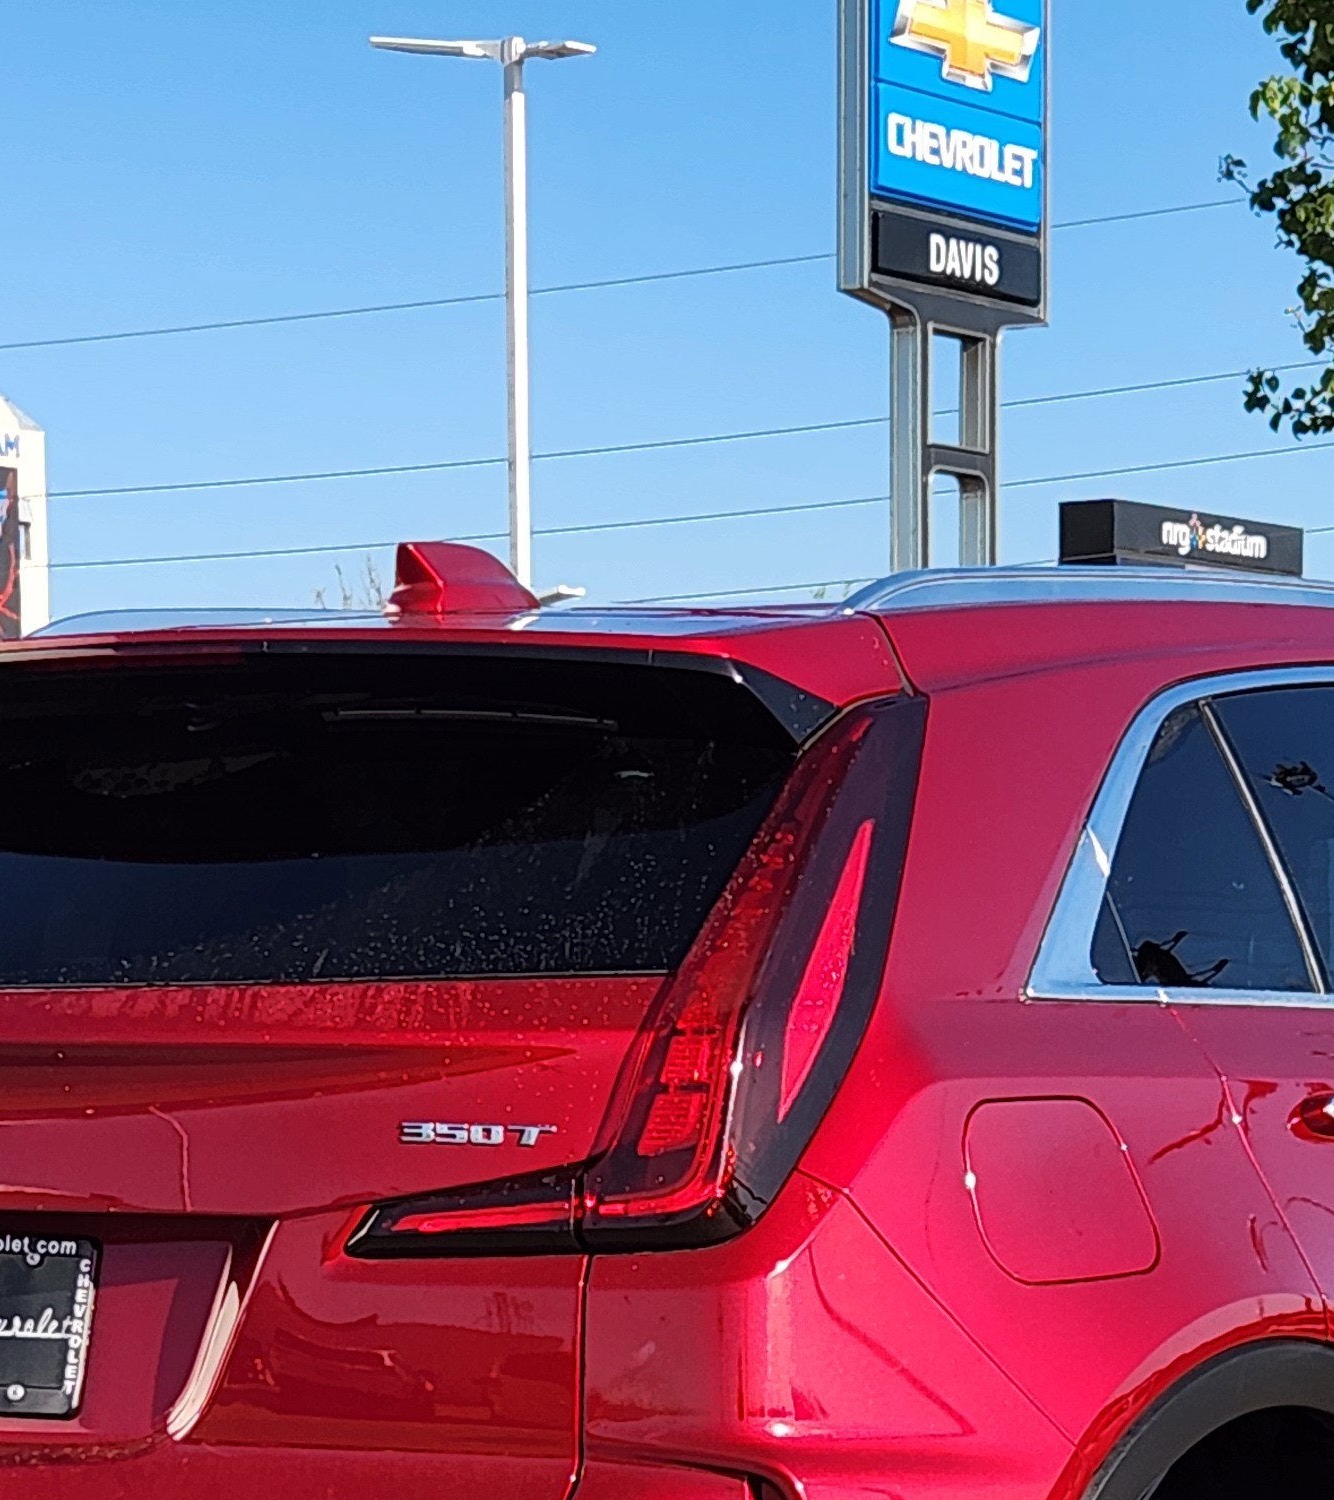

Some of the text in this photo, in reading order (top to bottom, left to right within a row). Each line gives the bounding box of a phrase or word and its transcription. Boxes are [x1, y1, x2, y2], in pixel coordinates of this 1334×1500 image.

[887, 111, 1038, 189] CHEVROLET
[929, 232, 1000, 286] DAVIS
[1161, 521, 1267, 559] nrg stadium
[63, 1258, 92, 1396] CHEVROLET
